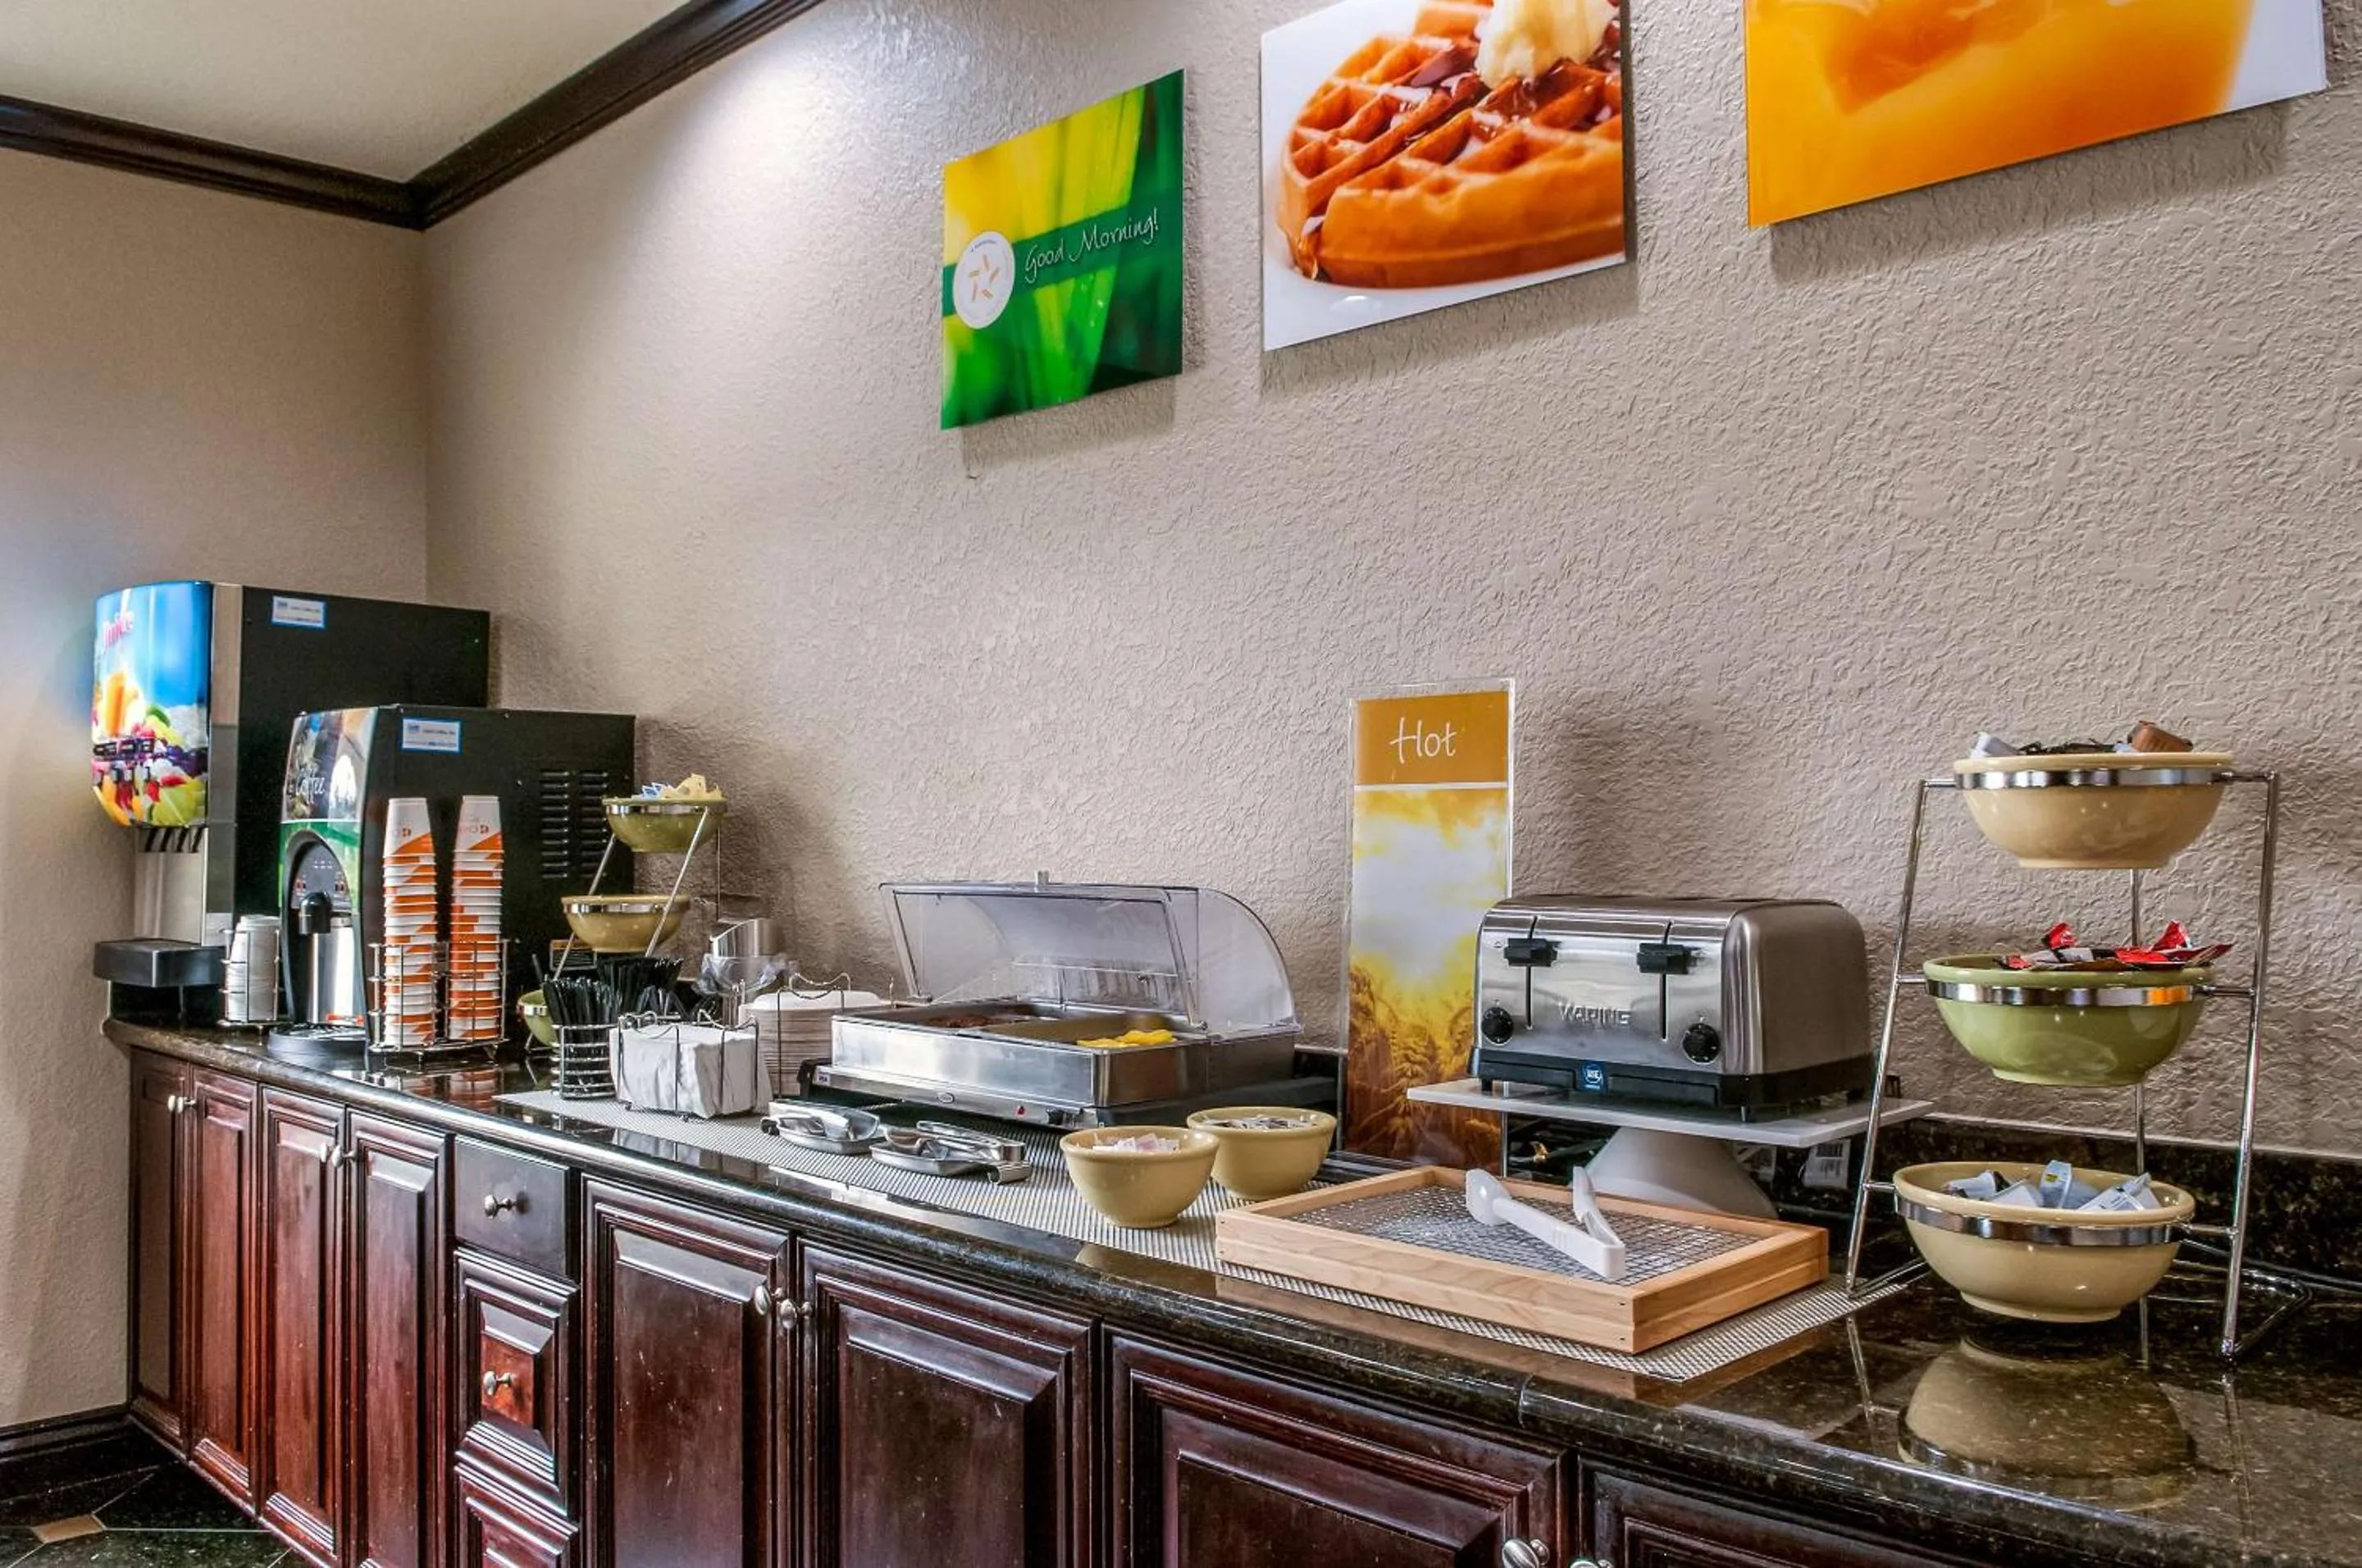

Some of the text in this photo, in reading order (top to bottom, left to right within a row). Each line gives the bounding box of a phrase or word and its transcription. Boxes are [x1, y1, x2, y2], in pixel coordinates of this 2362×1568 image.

[1024, 206, 1159, 284] Good Morning!
[1388, 717, 1457, 764] Hot
